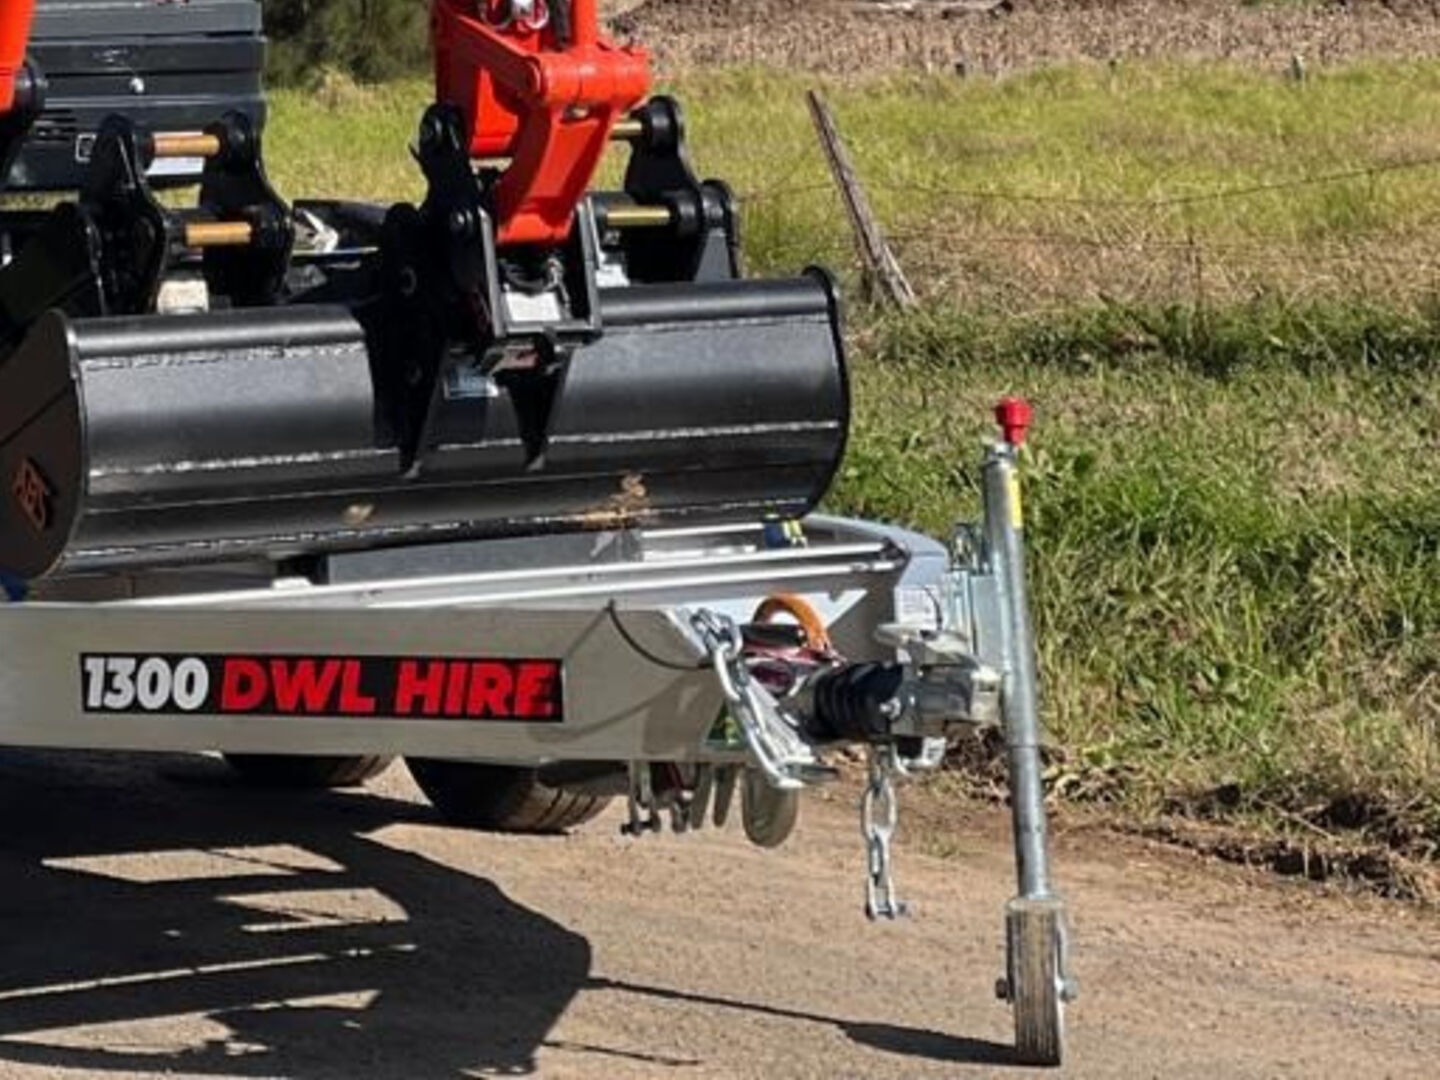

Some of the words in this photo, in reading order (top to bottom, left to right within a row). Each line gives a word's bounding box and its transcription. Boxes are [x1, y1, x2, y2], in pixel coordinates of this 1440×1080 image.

[84, 656, 209, 711] 1300
[220, 658, 376, 715] DWL
[395, 662, 557, 718] HIRE
